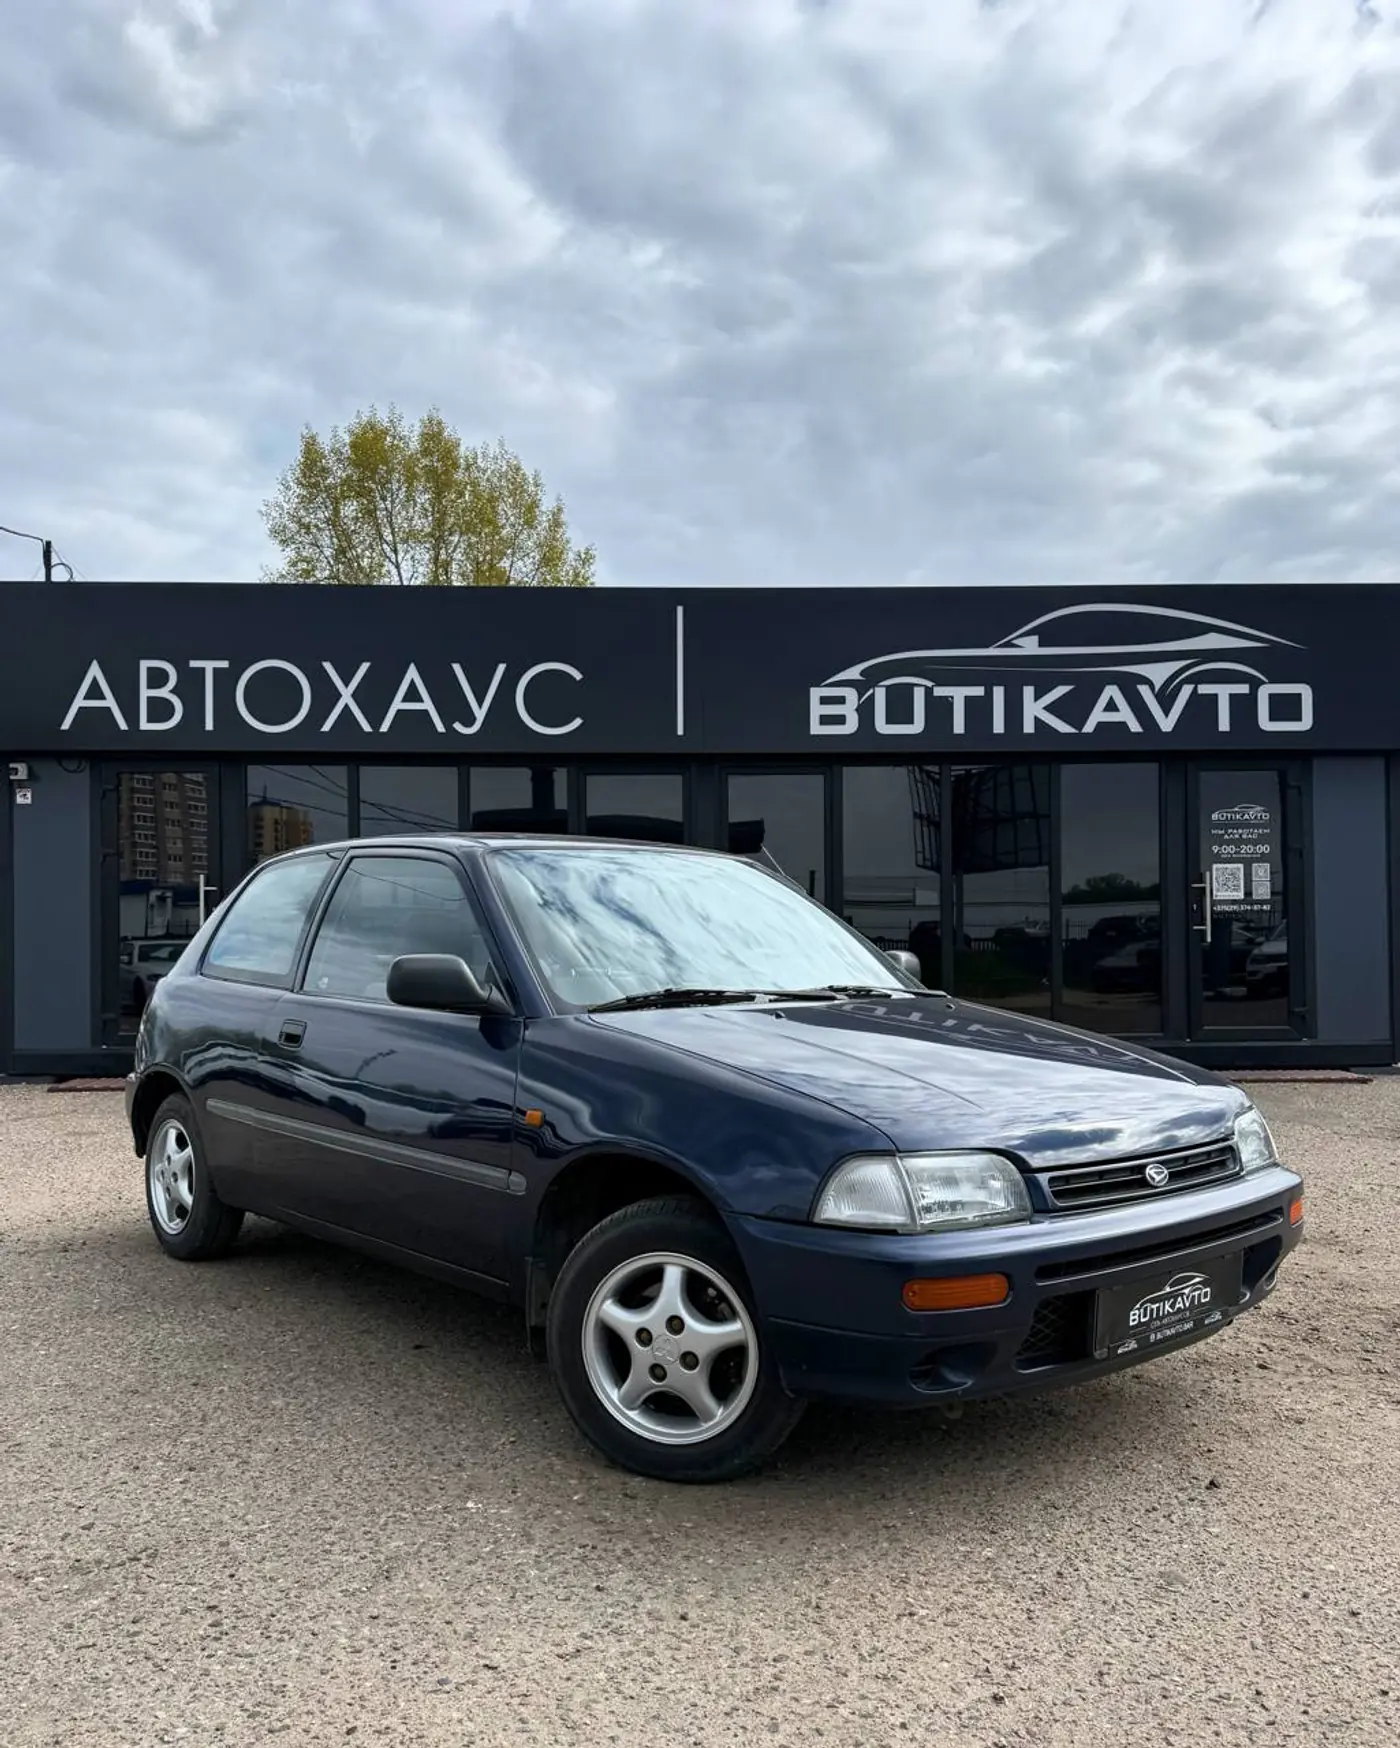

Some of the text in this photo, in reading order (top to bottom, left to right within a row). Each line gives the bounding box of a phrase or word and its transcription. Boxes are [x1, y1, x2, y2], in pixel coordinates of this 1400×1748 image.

[60, 658, 584, 735] АВТОХАУС
[809, 682, 1313, 735] BUTIKAVTO
[1211, 812, 1270, 821] BUTIKAVTO
[1212, 844, 1270, 853] 9:00-20:00
[1129, 1287, 1211, 1326] BUTIKAVTO
